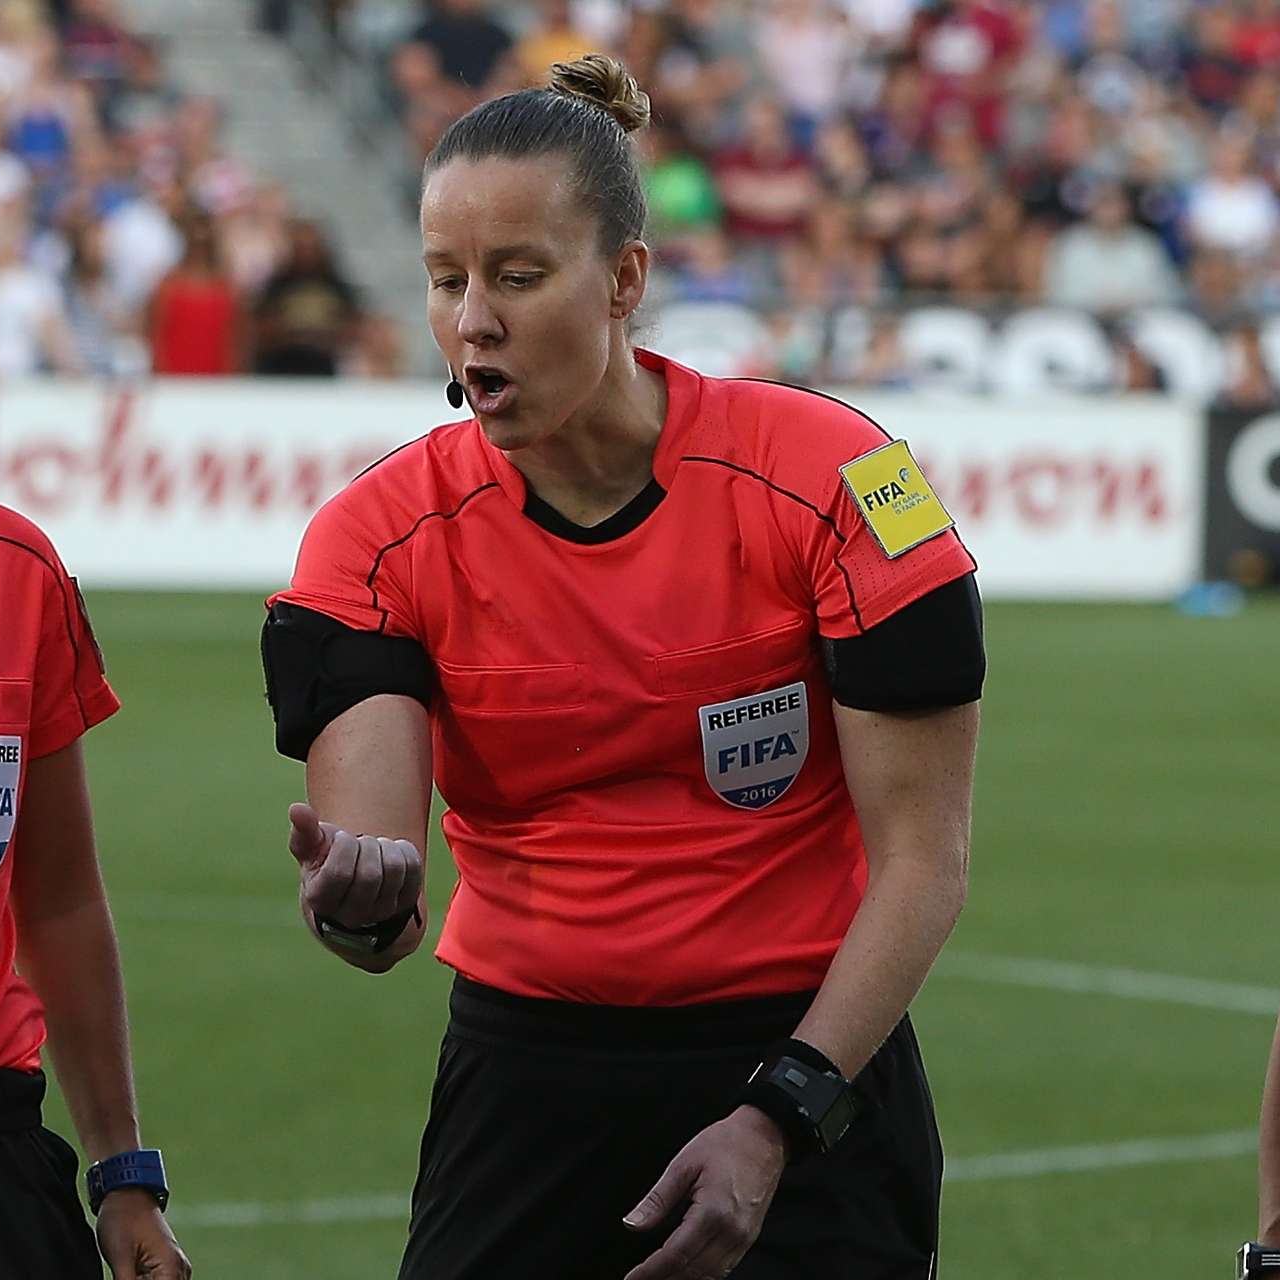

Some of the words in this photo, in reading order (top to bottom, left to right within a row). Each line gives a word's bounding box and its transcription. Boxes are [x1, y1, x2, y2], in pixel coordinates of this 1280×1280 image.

[863, 481, 906, 512] FIFA
[706, 692, 801, 731] REFEREE
[718, 732, 798, 775] FIFA
[740, 785, 777, 803] 2016
